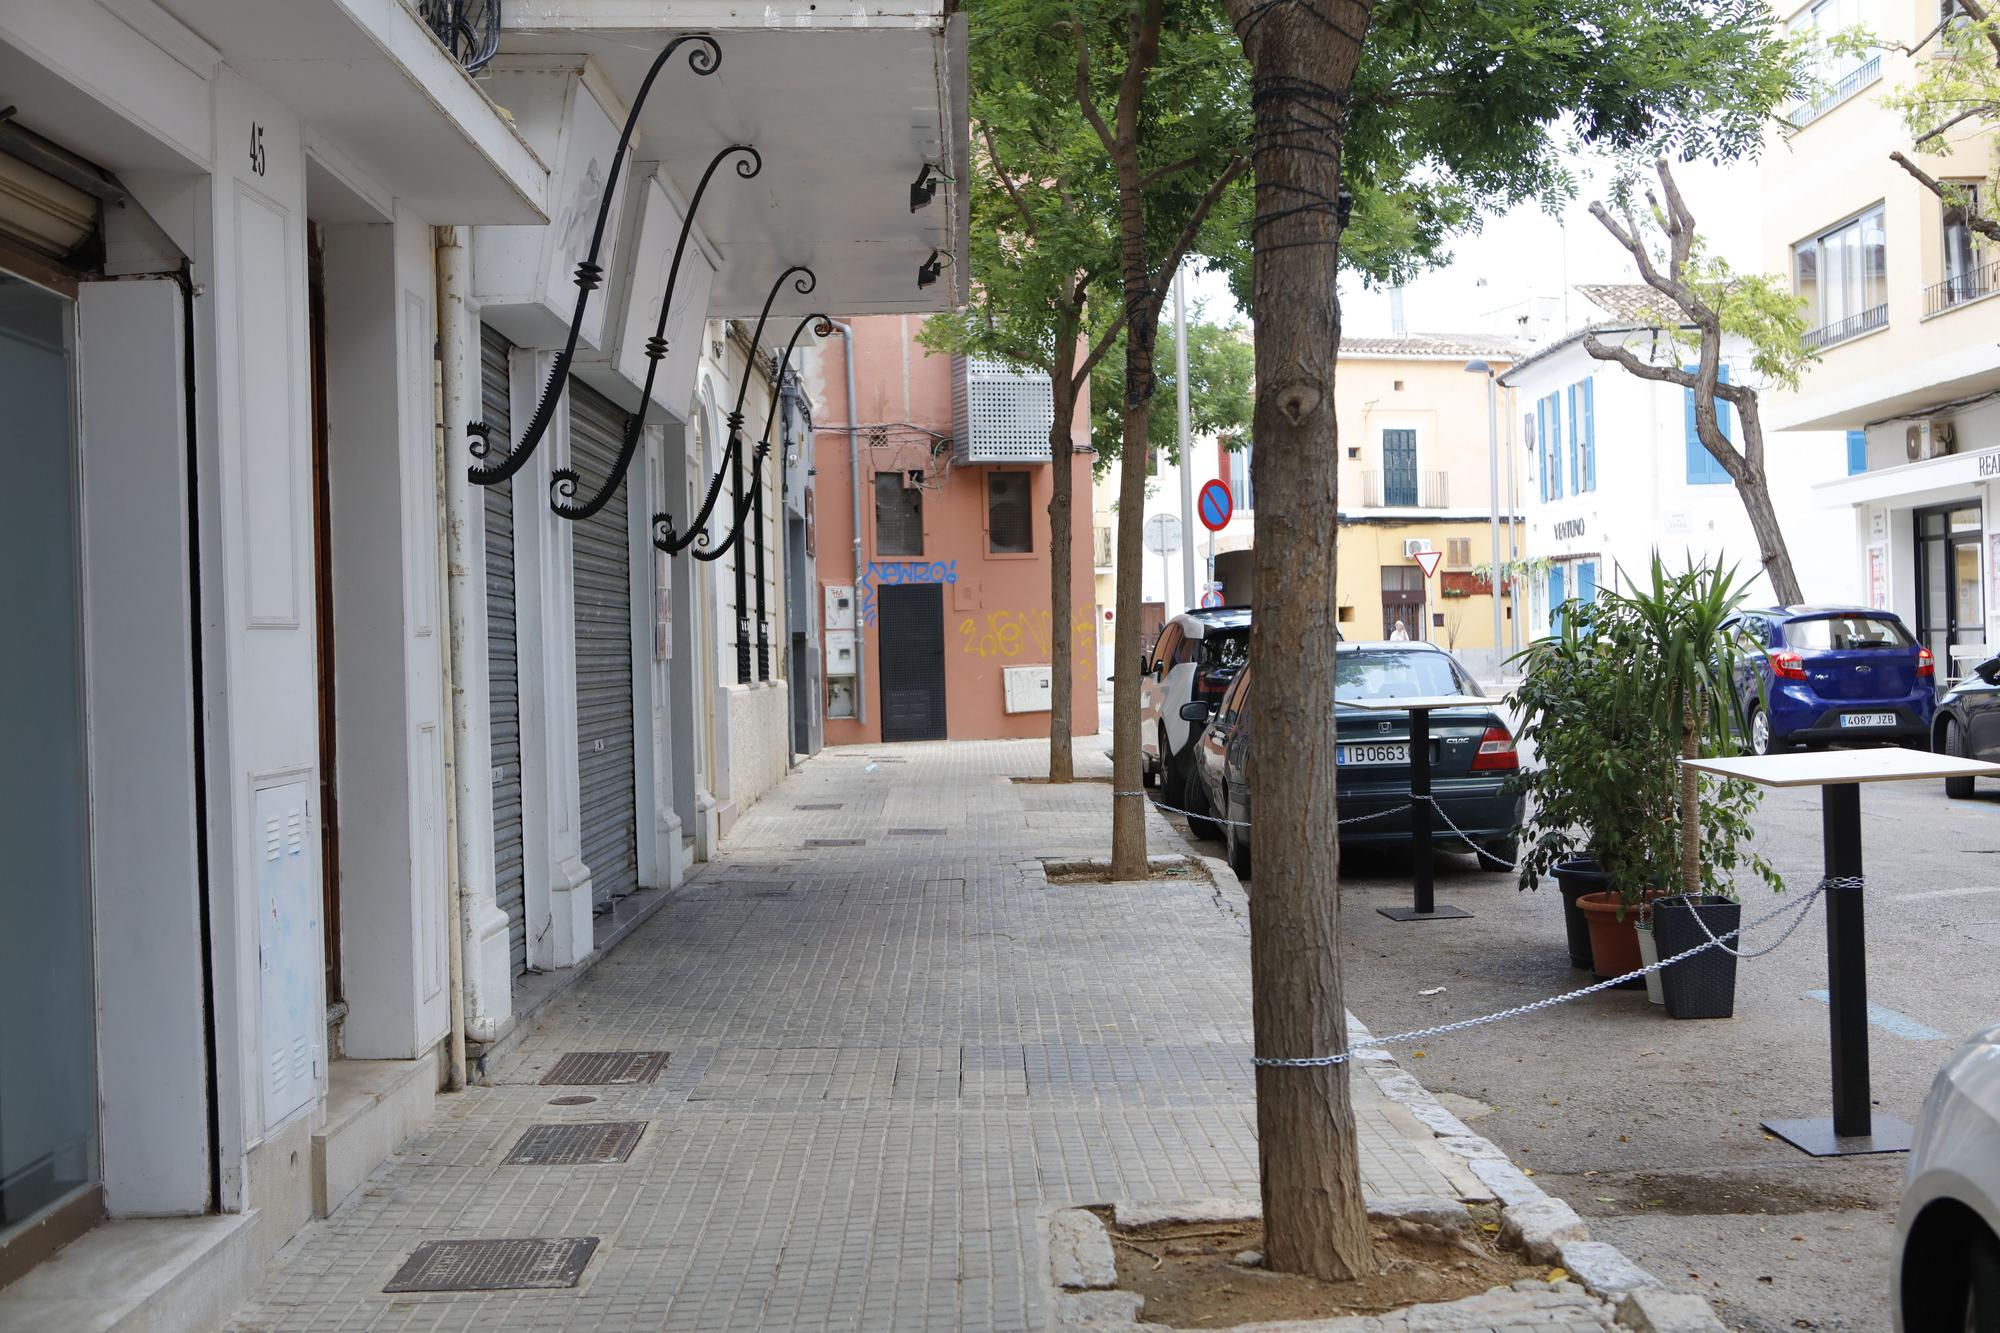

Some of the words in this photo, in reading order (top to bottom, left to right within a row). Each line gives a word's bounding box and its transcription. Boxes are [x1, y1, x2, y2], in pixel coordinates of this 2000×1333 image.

[249, 121, 266, 177] 45
[1553, 516, 1585, 541] VENTUNO
[1848, 715, 1872, 725] 4087
[1876, 714, 1894, 724] JZB
